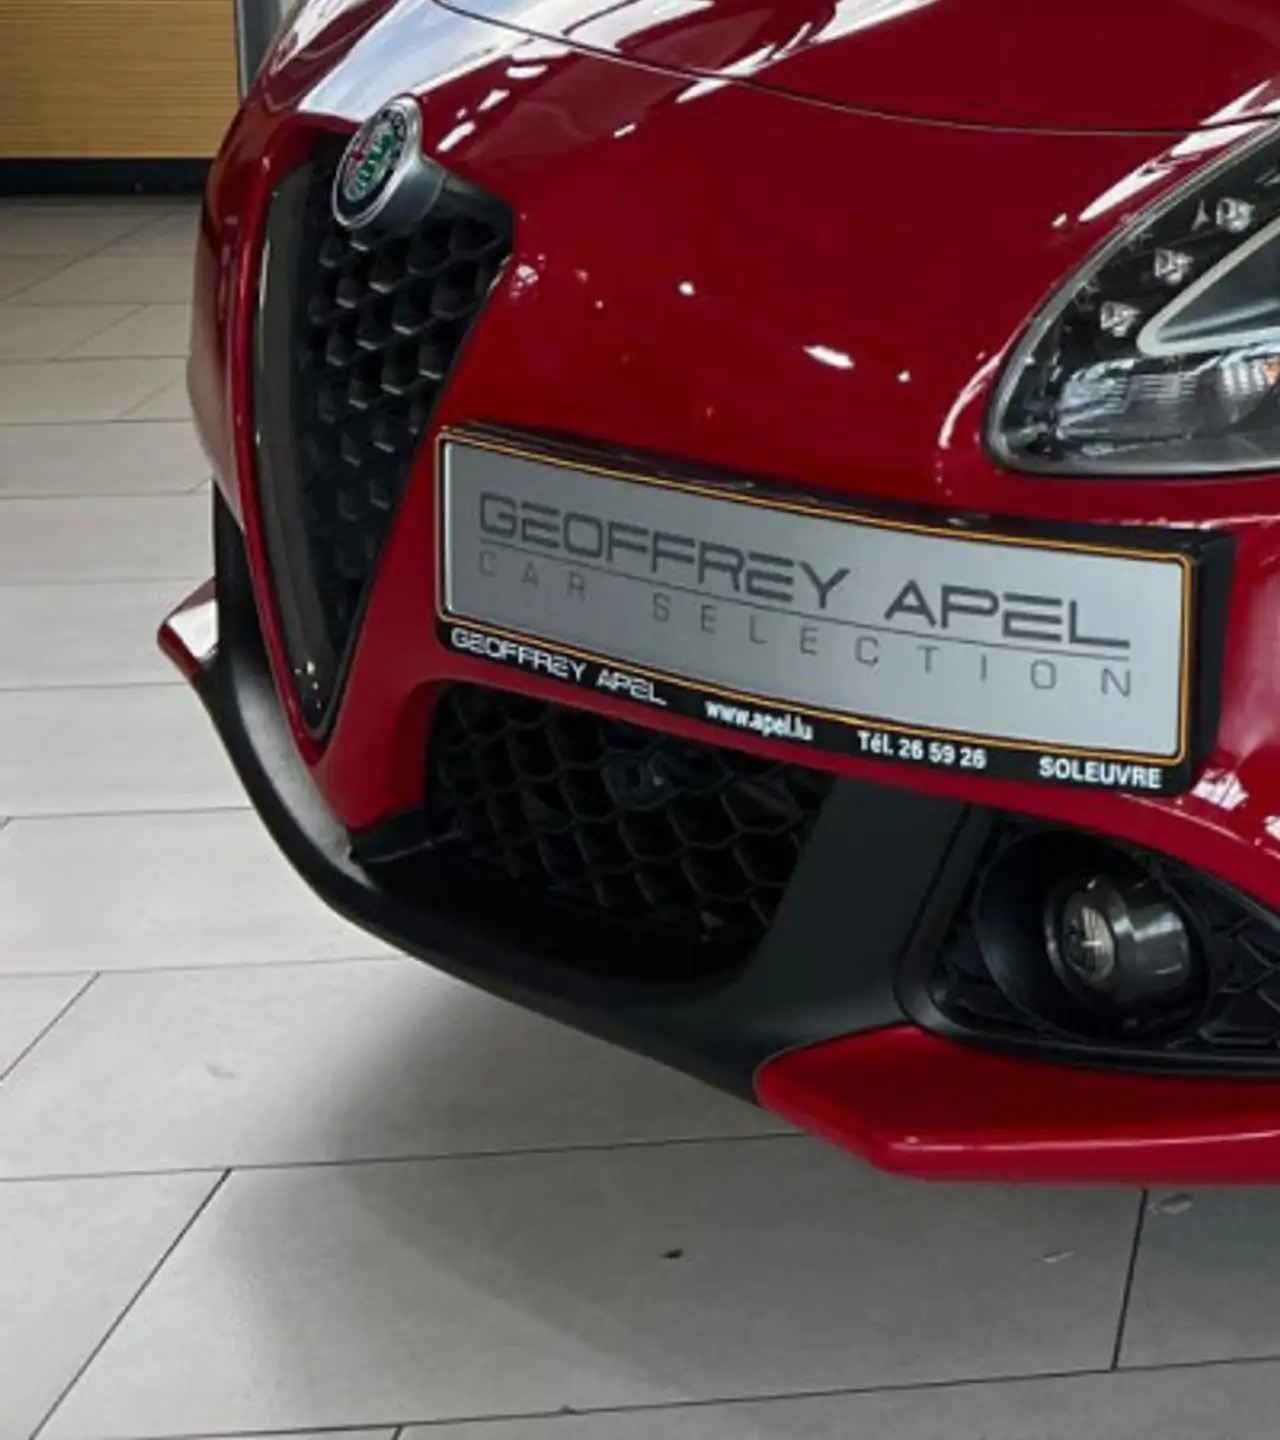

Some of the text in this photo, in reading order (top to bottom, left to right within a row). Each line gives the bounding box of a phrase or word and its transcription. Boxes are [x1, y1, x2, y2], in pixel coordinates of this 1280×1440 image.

[480, 492, 1131, 649] GEOFFREY APEL
[480, 550, 1131, 698] CAR SELECTION
[451, 626, 1163, 789] GEOFFREY APEL www.apel.lu Tél. 26 59 26 SOLEUVRE
